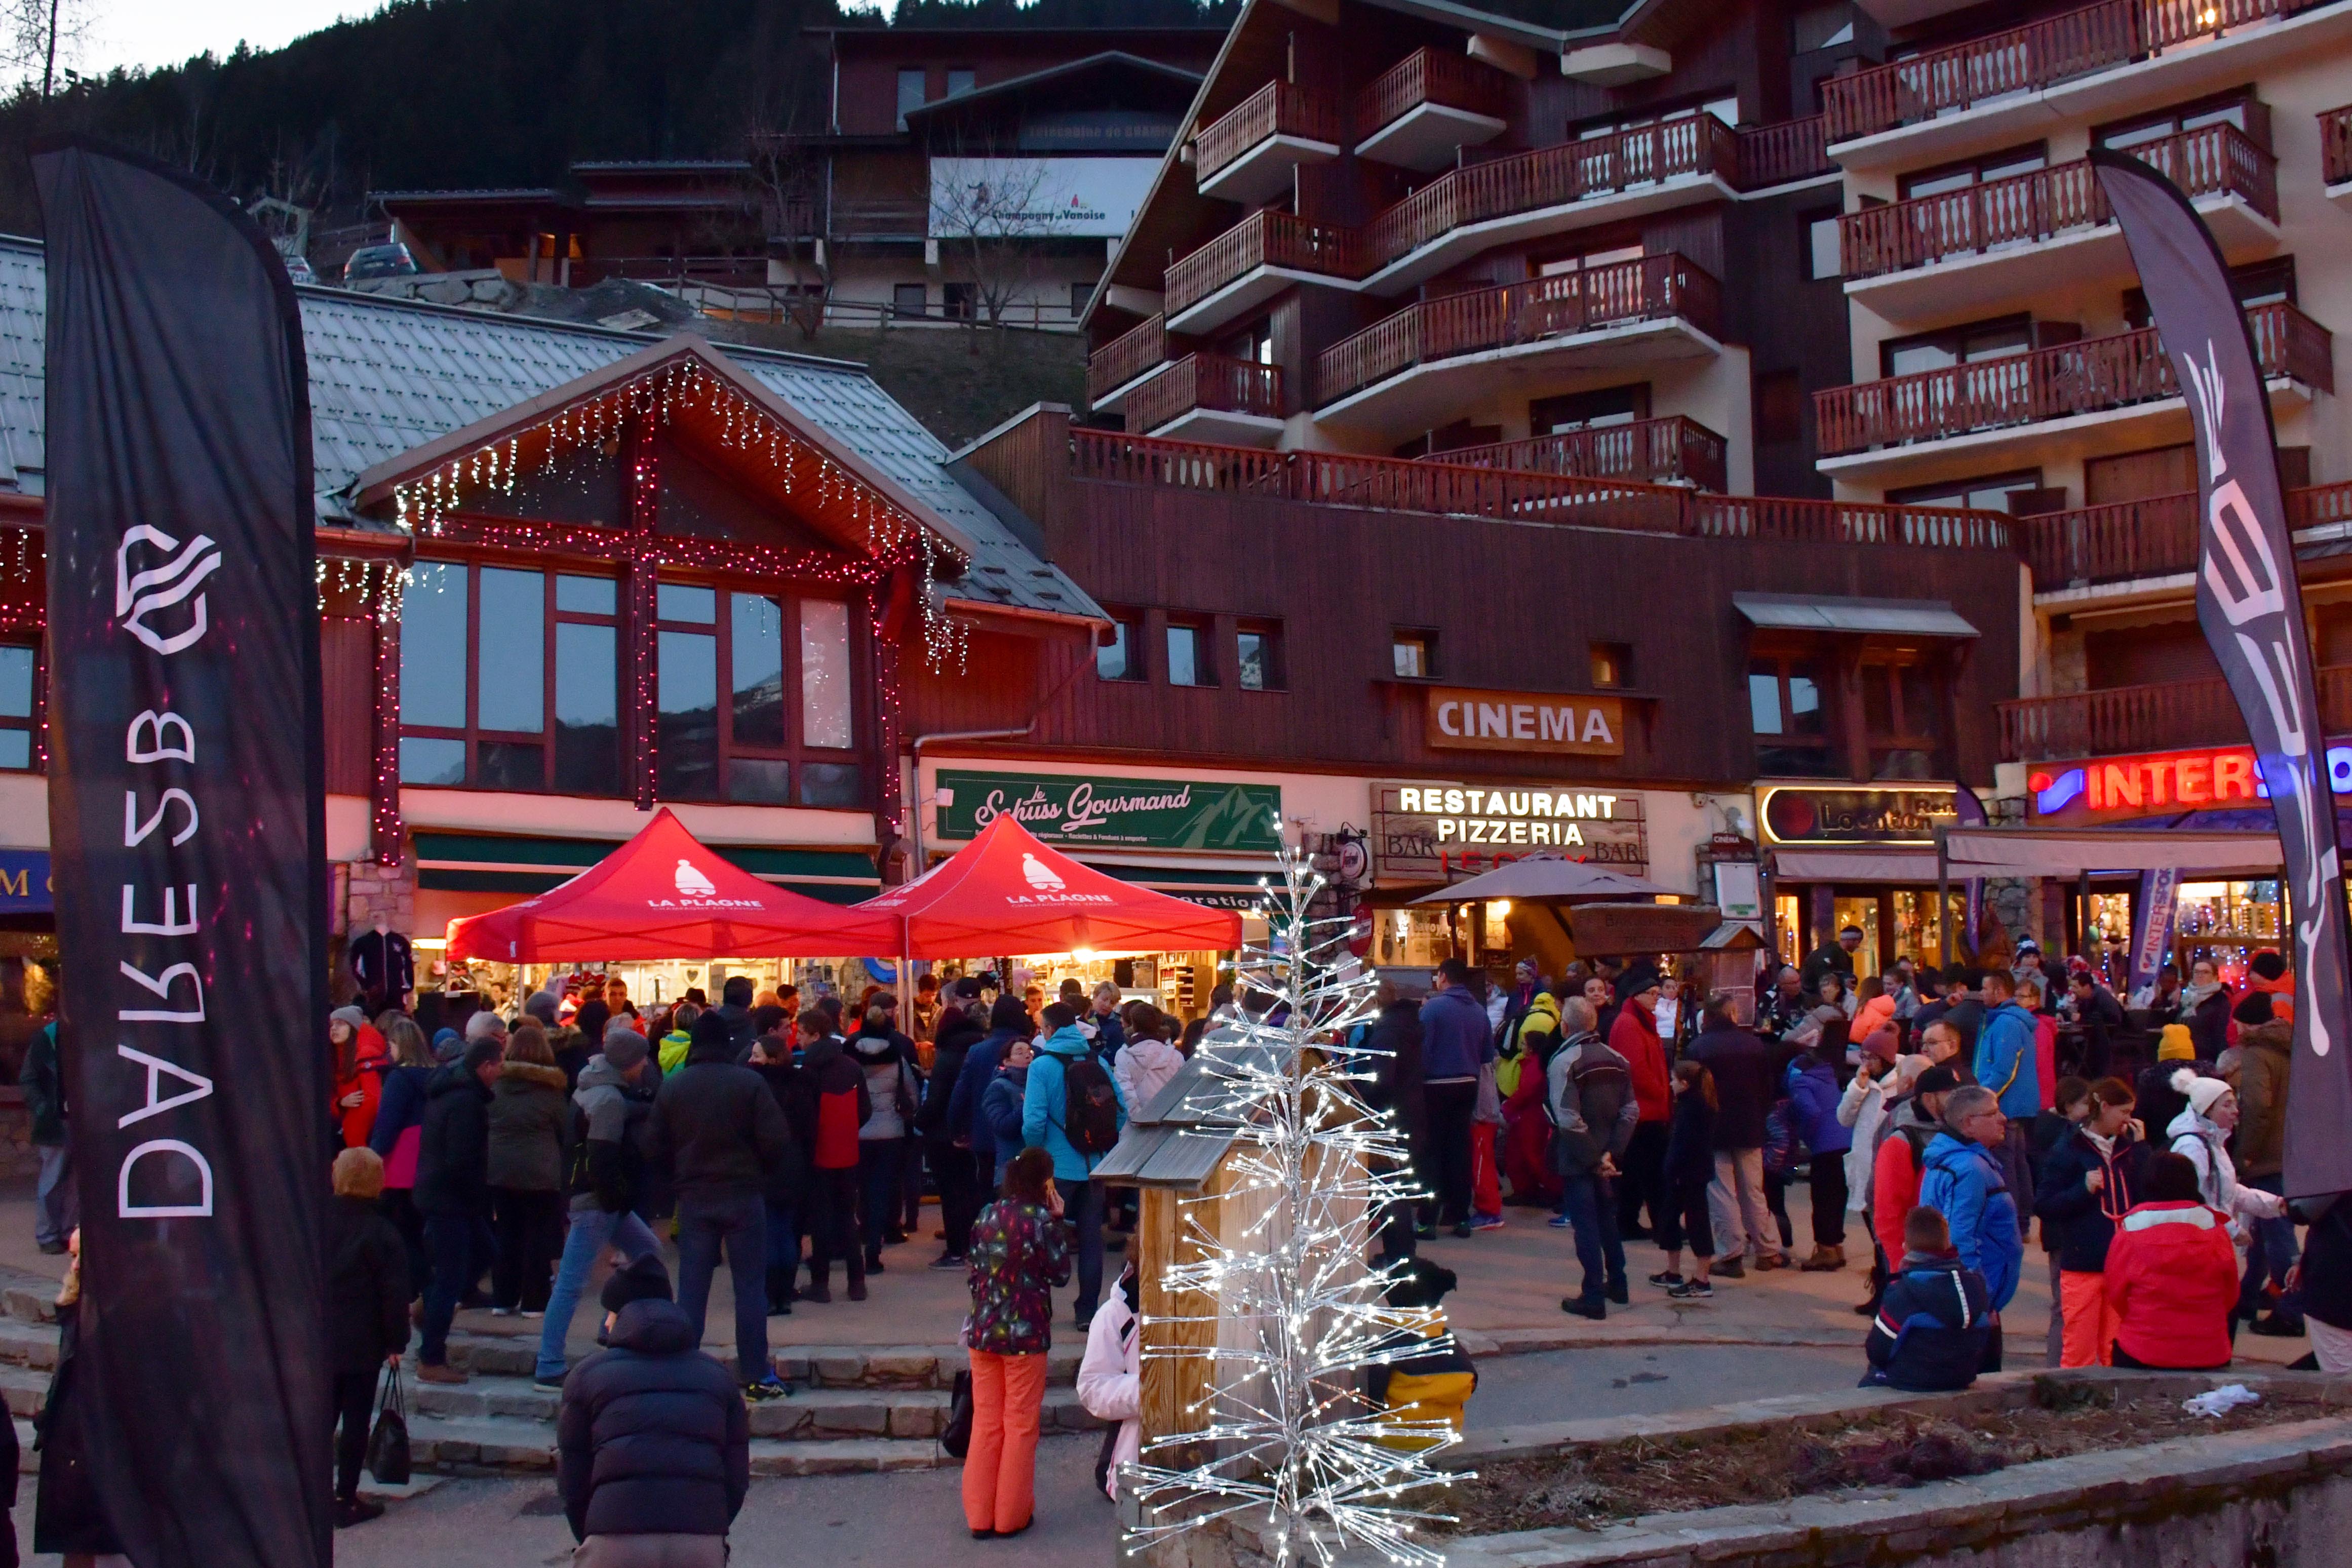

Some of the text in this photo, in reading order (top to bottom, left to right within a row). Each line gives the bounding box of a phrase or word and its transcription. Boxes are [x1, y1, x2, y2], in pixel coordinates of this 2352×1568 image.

[1063, 210, 1105, 220] Vanoise
[1438, 701, 1614, 742] CINEMA
[2088, 746, 2352, 810] INTERO
[1023, 785, 1046, 805] Le
[1061, 783, 1190, 832] Gourmand
[1400, 788, 1617, 818] RESTAURANT
[1437, 819, 1585, 846] PIZZERIA
[1388, 836, 1435, 856] BAR
[1595, 842, 1639, 861] BAR
[680, 899, 762, 907] PLAGNE
[1006, 894, 1113, 904] LA PLAGNE
[1174, 896, 1262, 909] oration
